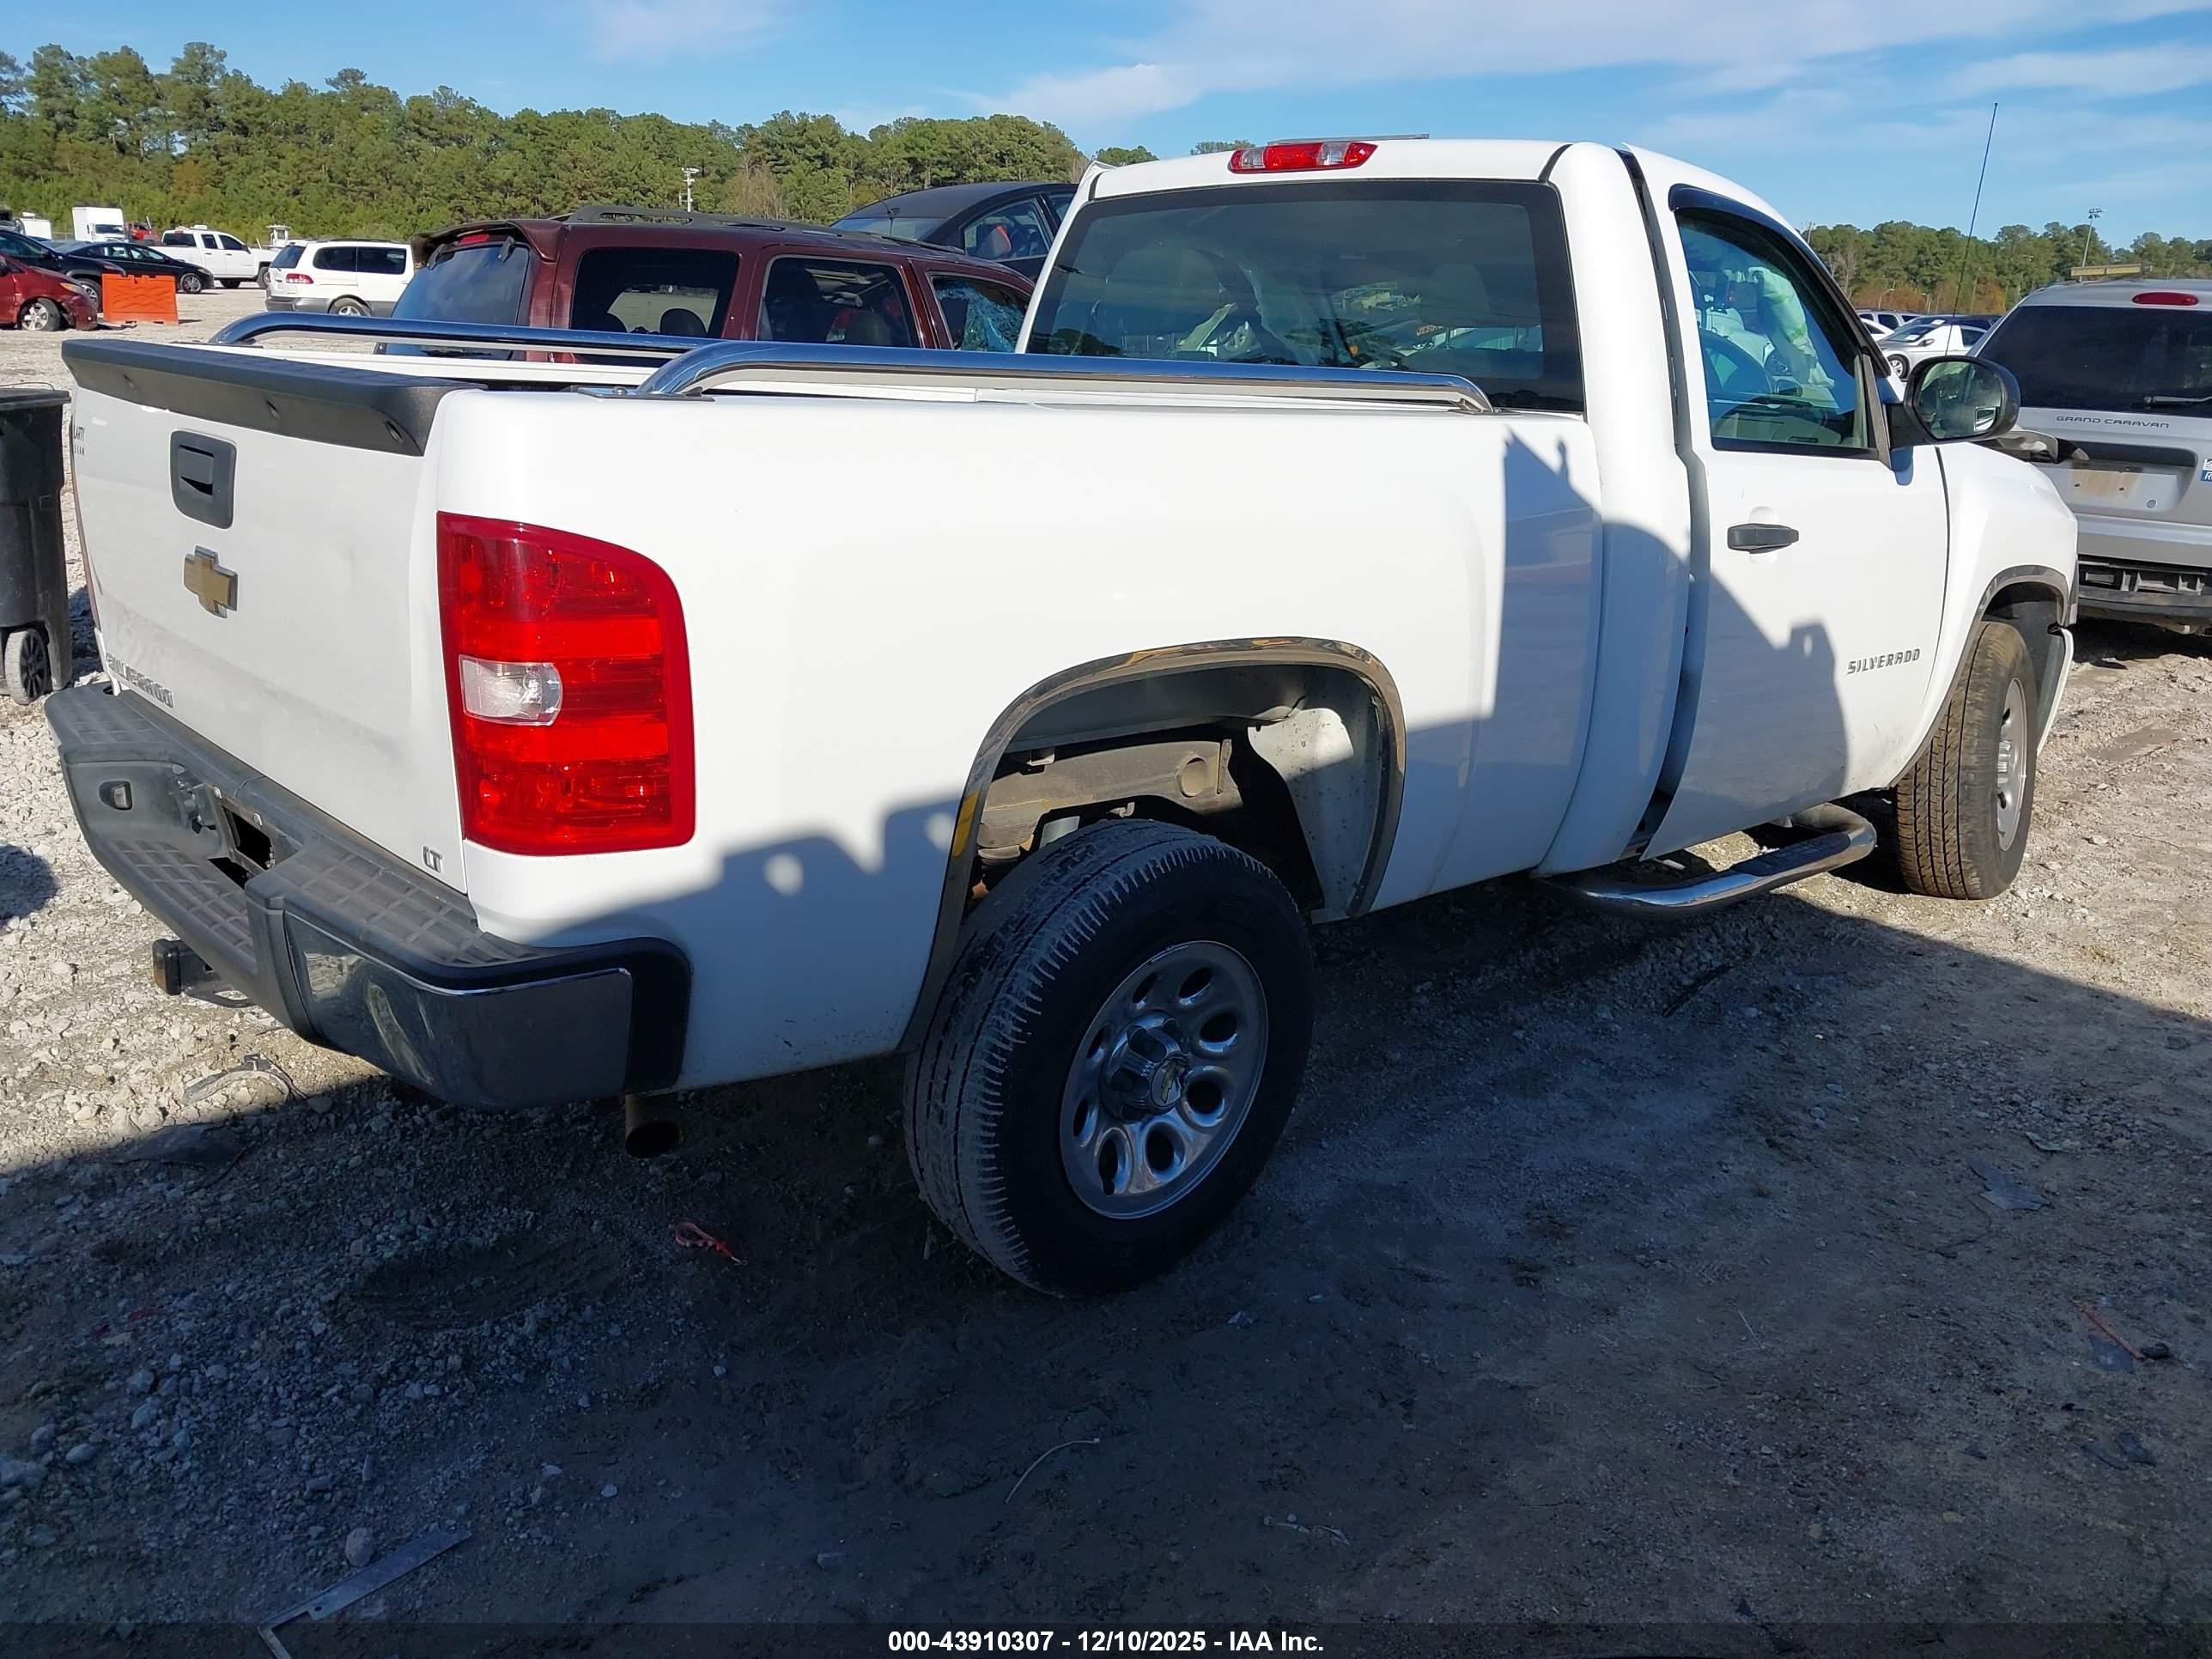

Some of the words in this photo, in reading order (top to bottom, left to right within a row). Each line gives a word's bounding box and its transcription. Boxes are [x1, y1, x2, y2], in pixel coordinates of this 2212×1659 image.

[2105, 419, 2169, 428] CARAVAN
[1847, 648, 1920, 674] SILVERADO
[423, 846, 442, 873] LT
